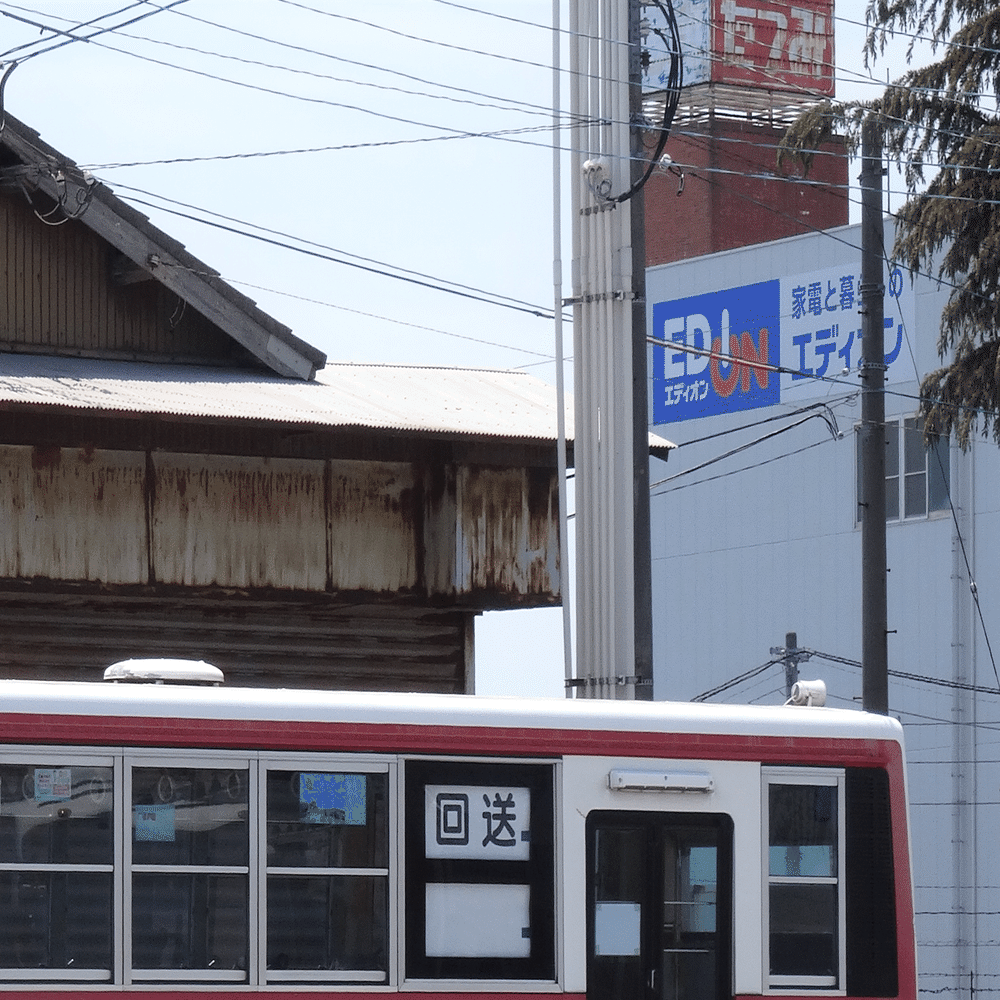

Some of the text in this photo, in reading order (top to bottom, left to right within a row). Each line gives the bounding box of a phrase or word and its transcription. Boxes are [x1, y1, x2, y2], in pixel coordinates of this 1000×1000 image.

[792, 269, 903, 320] 家電と暮の
[792, 317, 903, 381] エディン
[664, 379, 710, 406] エディオン
[436, 792, 517, 848] 回送
